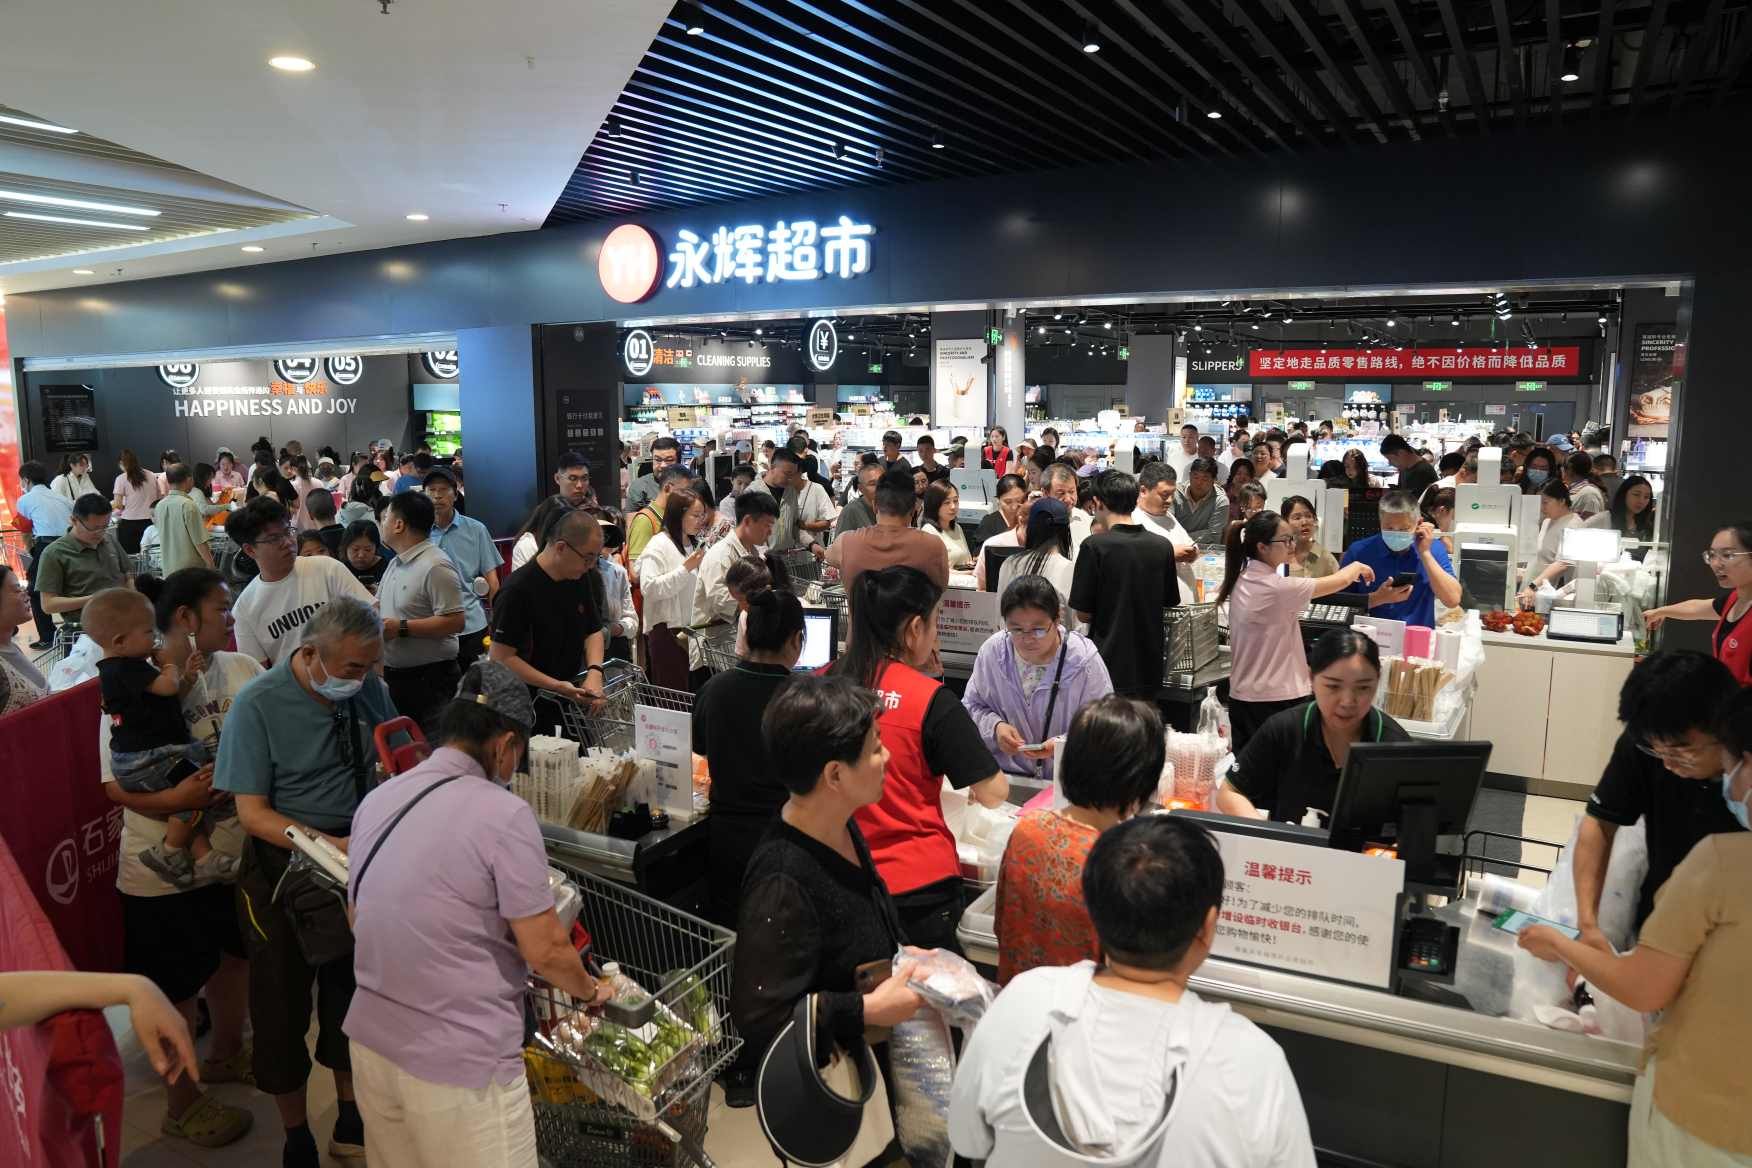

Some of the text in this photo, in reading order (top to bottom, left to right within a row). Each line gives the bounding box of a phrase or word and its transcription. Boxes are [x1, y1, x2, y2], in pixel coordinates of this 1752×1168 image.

[666, 215, 875, 289] 永辉超市
[630, 338, 649, 360] 01
[697, 354, 771, 368] CLEANING SUPPLIES
[174, 398, 357, 417] HAPPINESS AND JOY
[1244, 860, 1313, 886] 温馨提示
